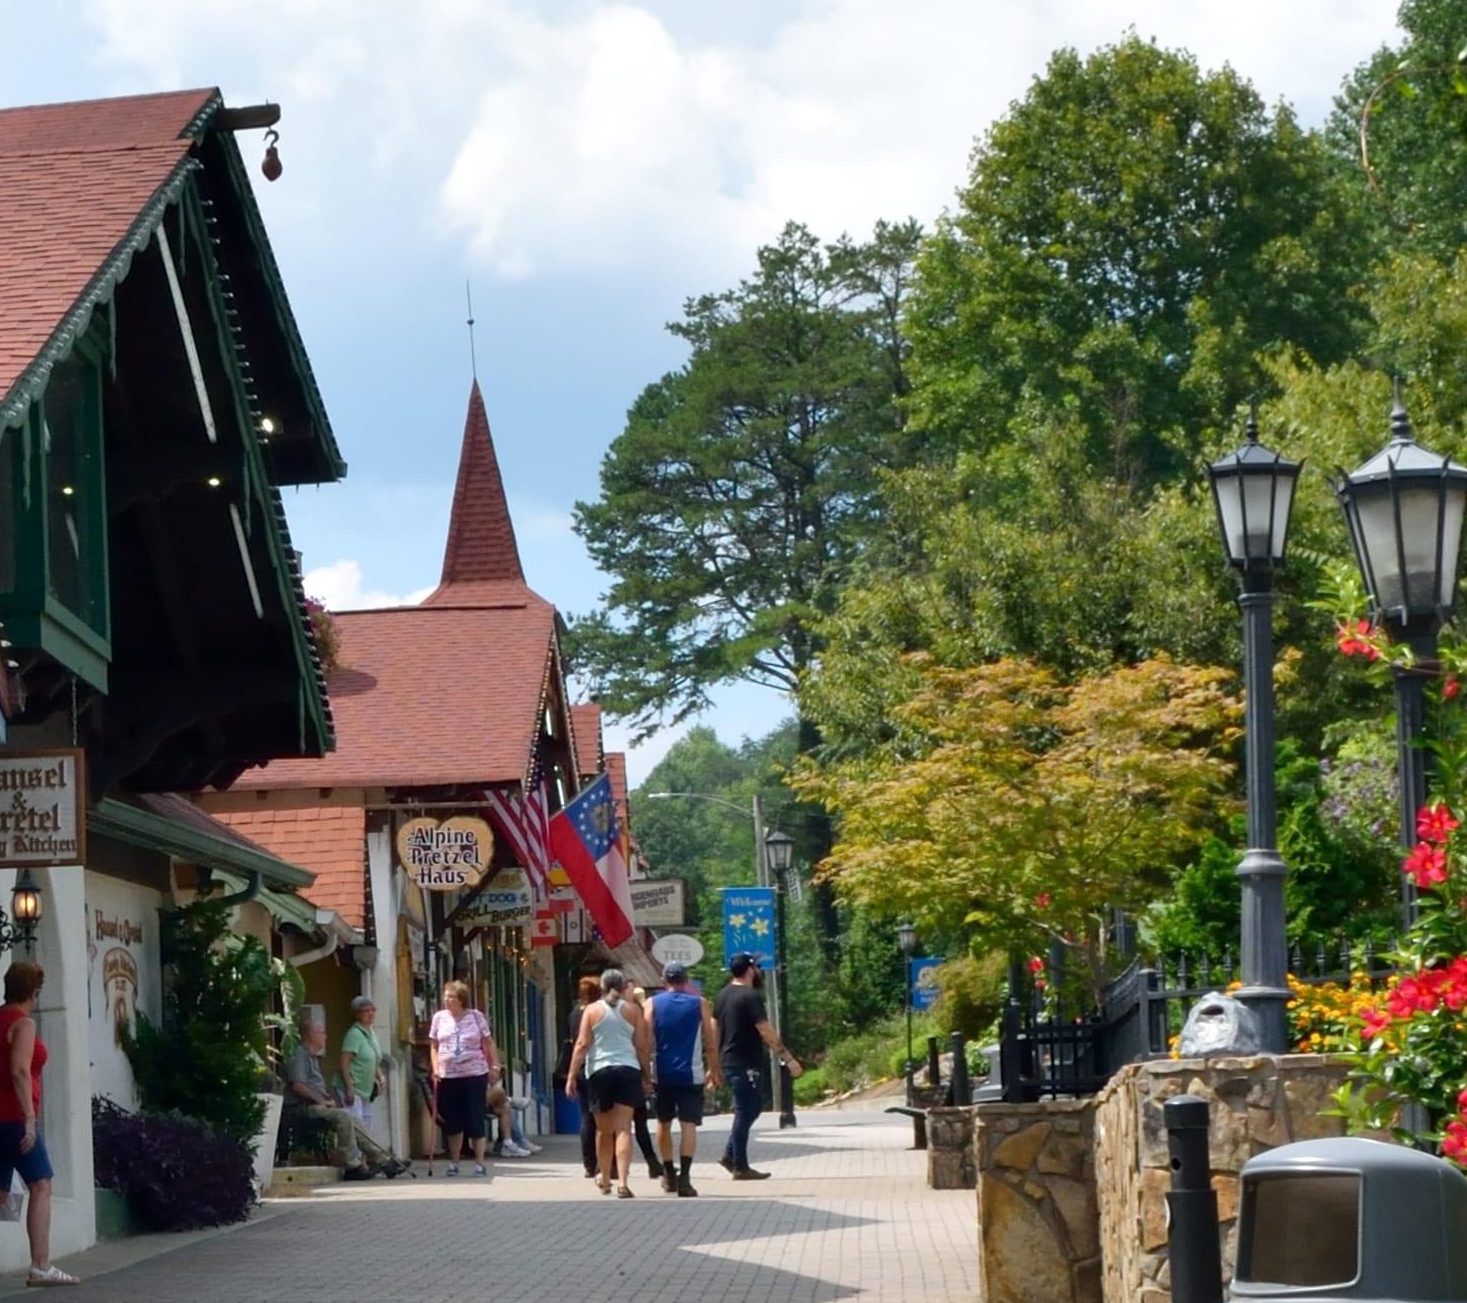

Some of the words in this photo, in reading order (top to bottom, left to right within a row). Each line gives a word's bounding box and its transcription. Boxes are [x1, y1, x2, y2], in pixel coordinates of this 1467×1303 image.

[11, 791, 28, 811] &
[13, 834, 78, 857] Kitchen
[408, 826, 476, 849] Alpine
[408, 846, 484, 866] Pretzel
[415, 866, 469, 884] Haus
[488, 892, 517, 903] DOG
[662, 950, 693, 962] TEES
